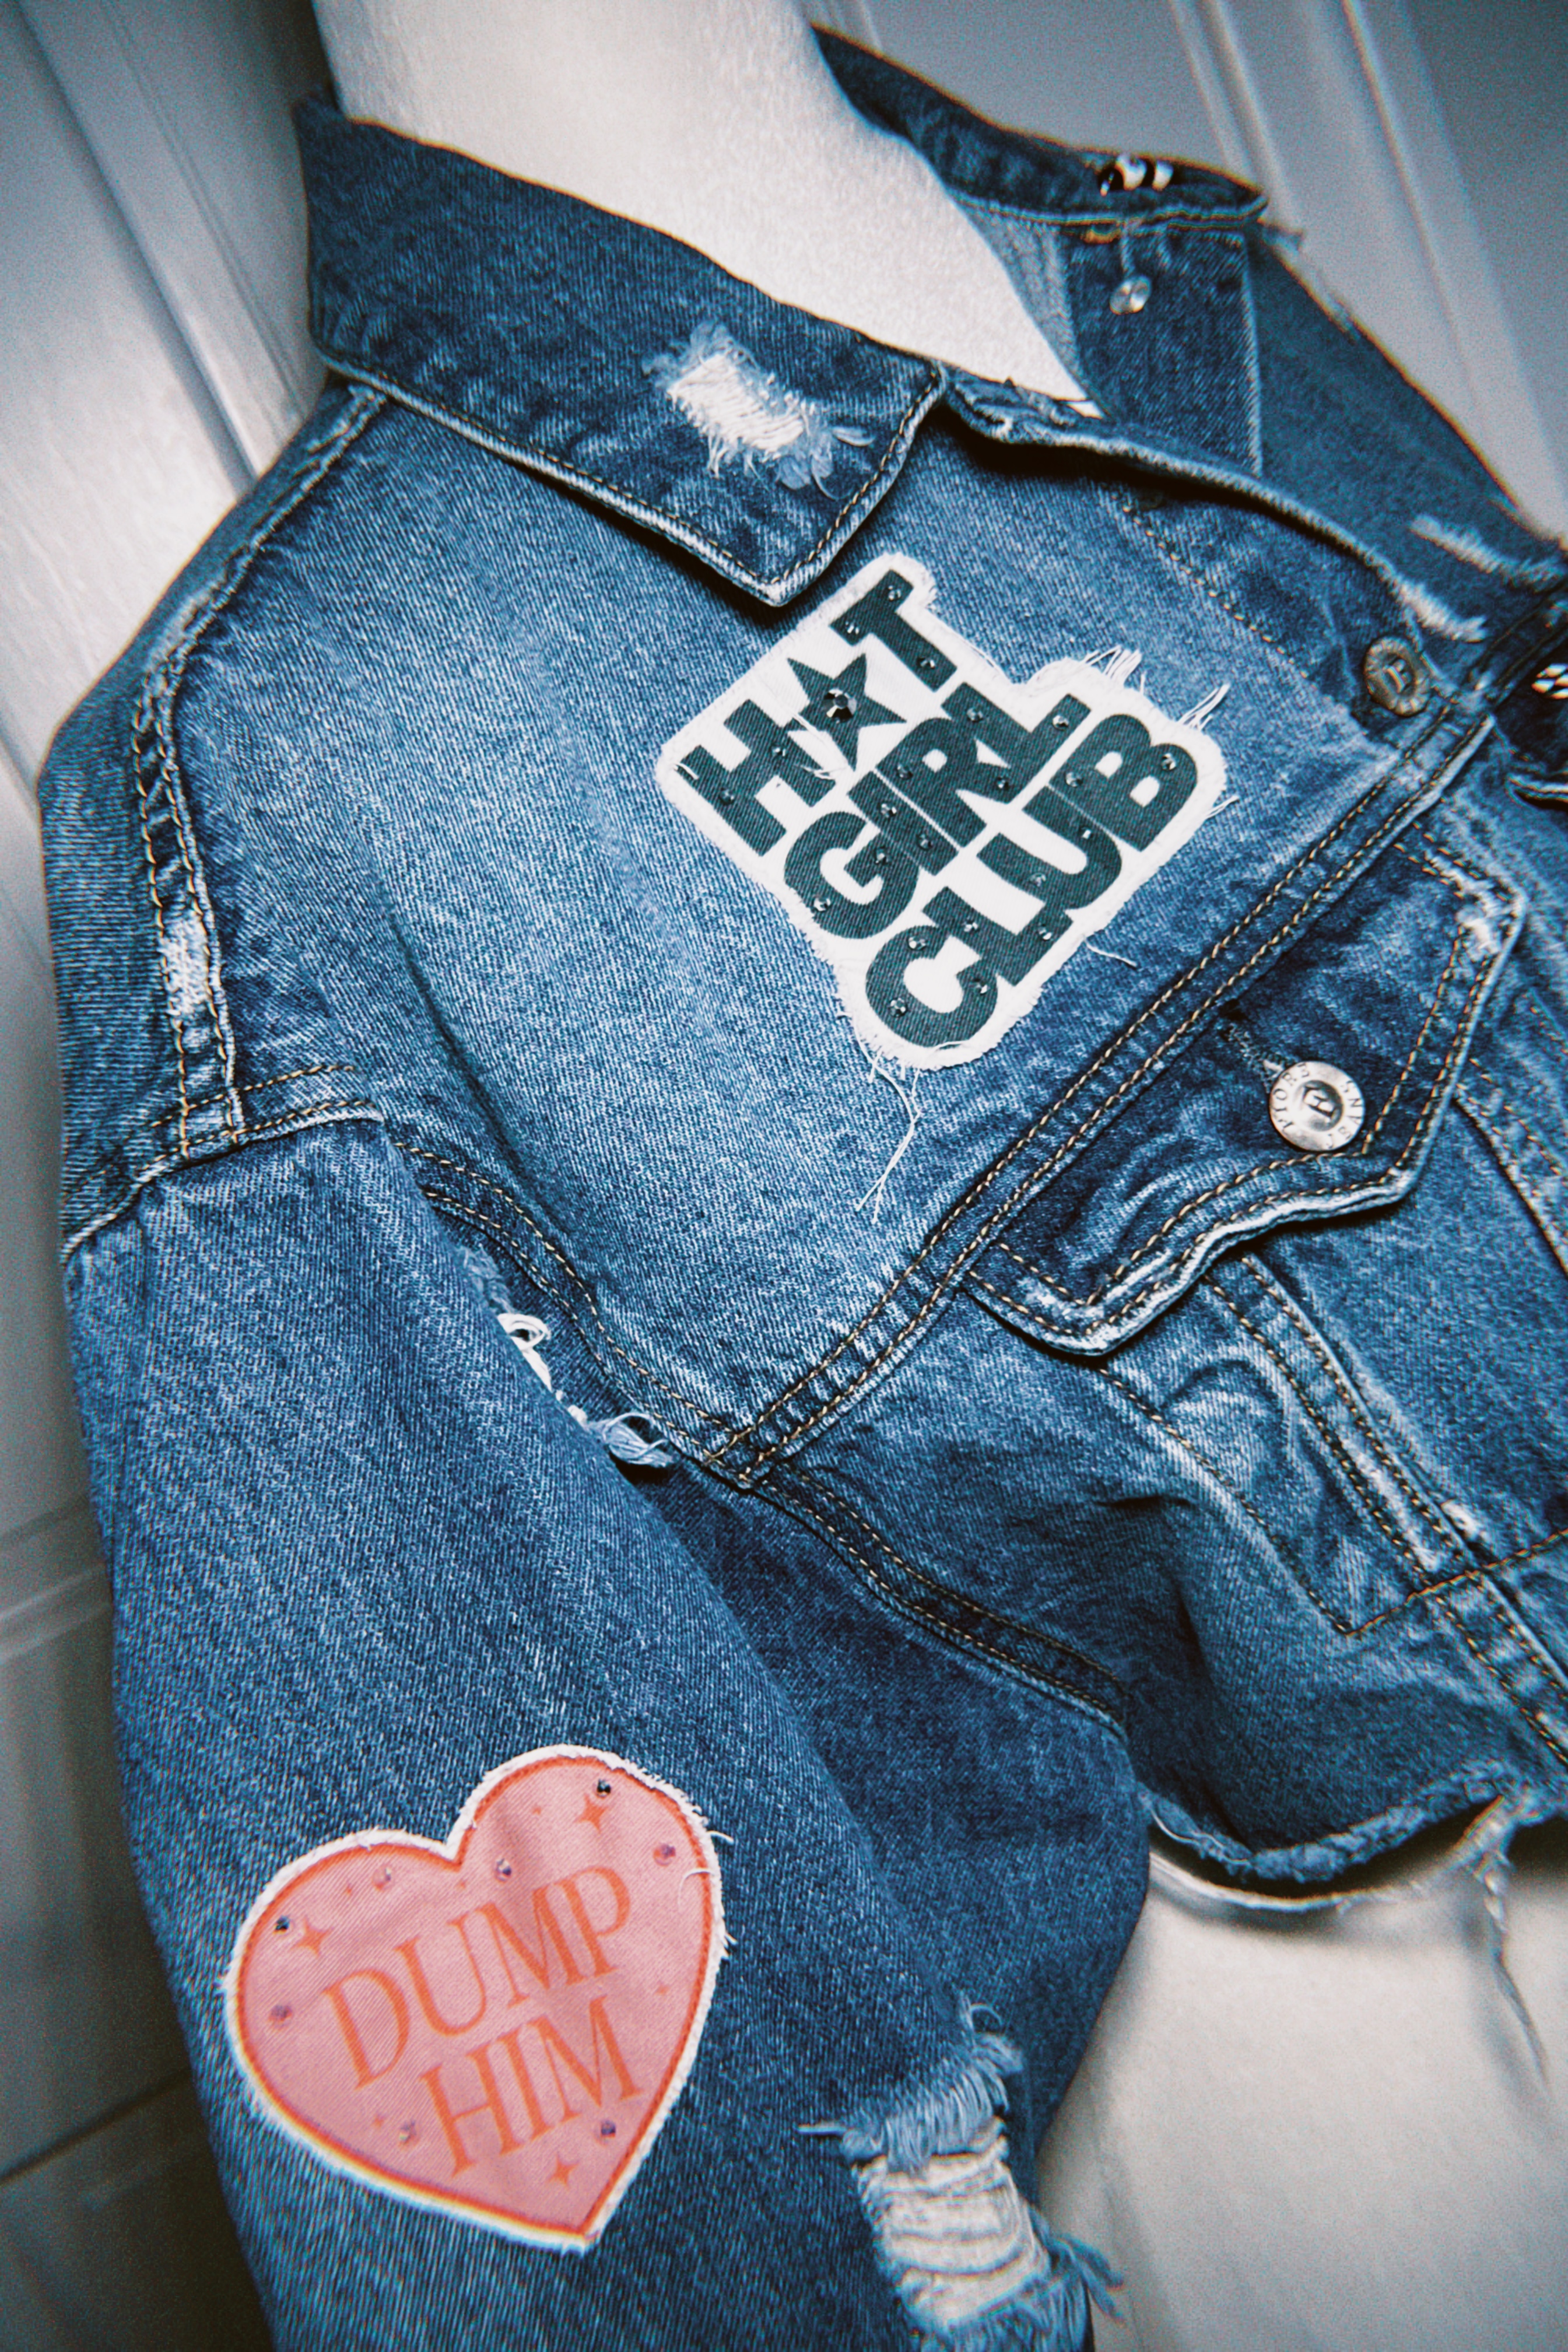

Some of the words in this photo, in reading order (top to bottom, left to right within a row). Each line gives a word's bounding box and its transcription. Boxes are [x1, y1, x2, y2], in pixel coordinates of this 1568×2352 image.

[784, 682, 1090, 939] GIRL
[865, 714, 1198, 1047] CLUB
[322, 1866, 632, 2090] DUMP
[419, 1995, 643, 2178] HIM
